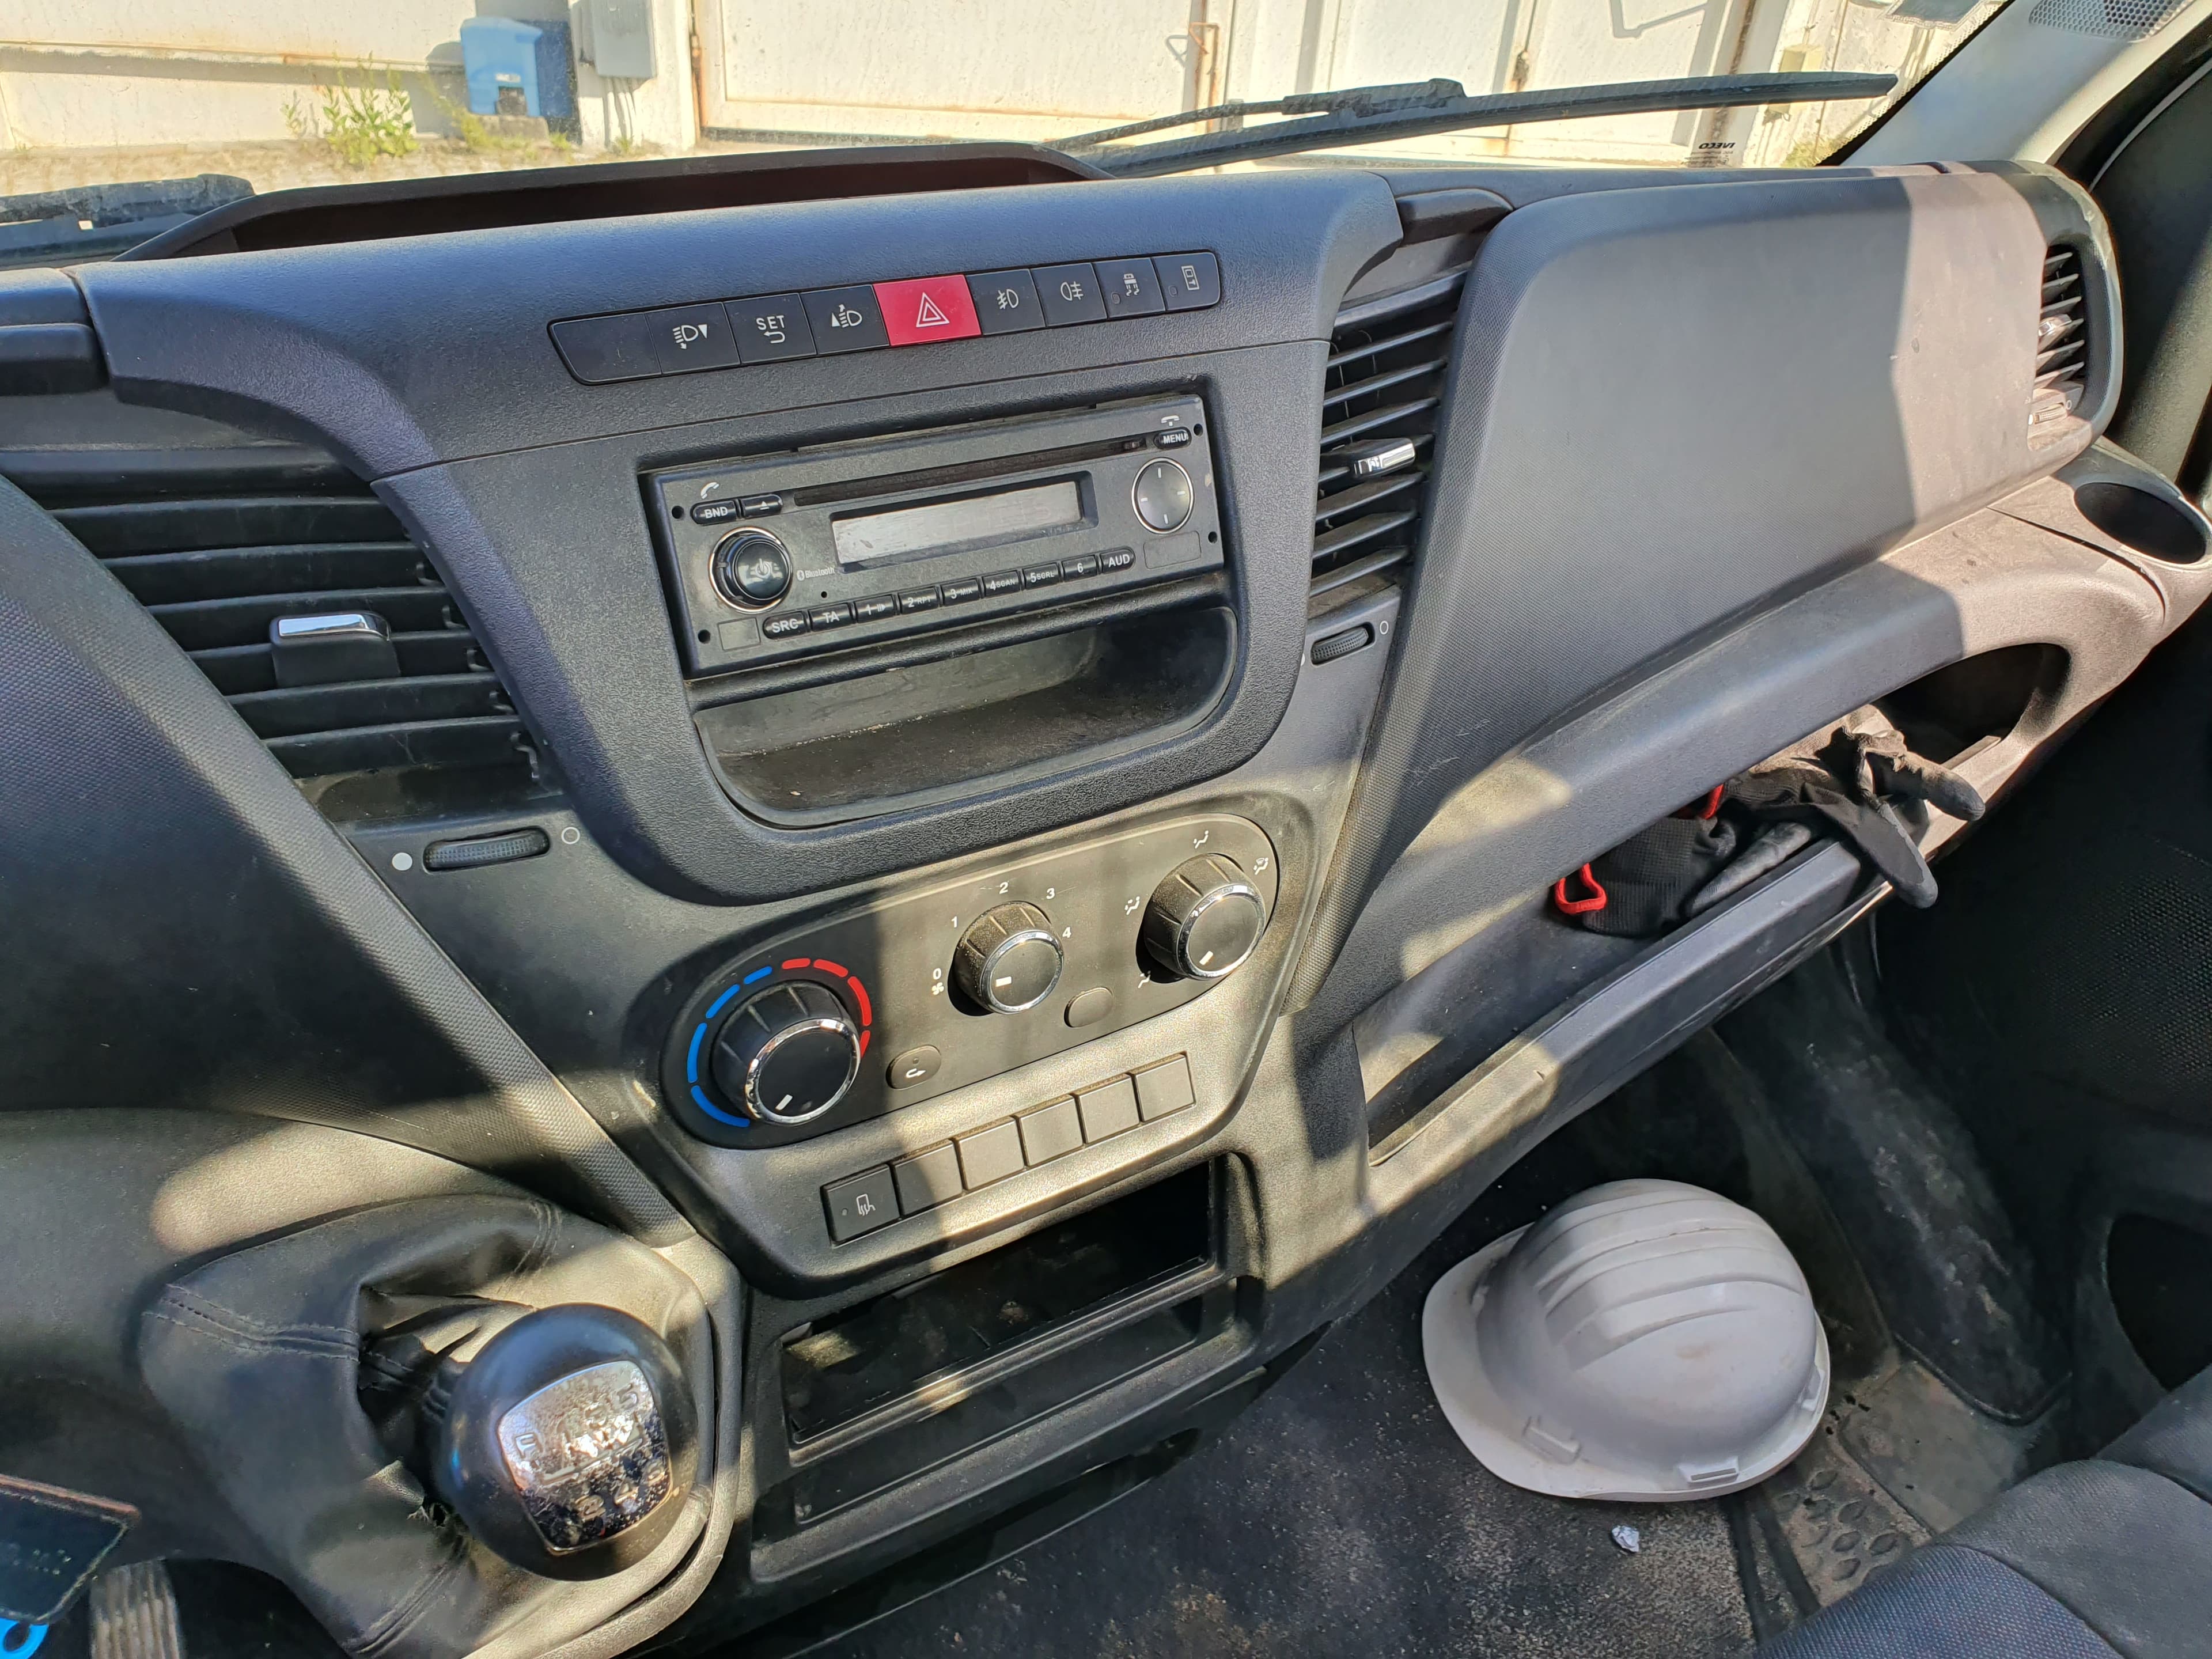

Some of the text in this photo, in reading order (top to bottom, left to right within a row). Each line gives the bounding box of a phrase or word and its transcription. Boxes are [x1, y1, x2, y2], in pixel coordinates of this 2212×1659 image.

[756, 315, 785, 330] SET
[1163, 433, 1187, 444] MENU
[704, 506, 728, 518] BND
[1108, 553, 1130, 568] AUD
[805, 566, 835, 578] Bluetooth
[1077, 562, 1084, 573] 6
[822, 611, 840, 624] TA
[771, 618, 798, 633] SRC
[999, 882, 1009, 894] 2
[1046, 888, 1055, 899] 3
[951, 916, 959, 928] 1
[1062, 926, 1072, 938] 4
[933, 968, 942, 980] 0
